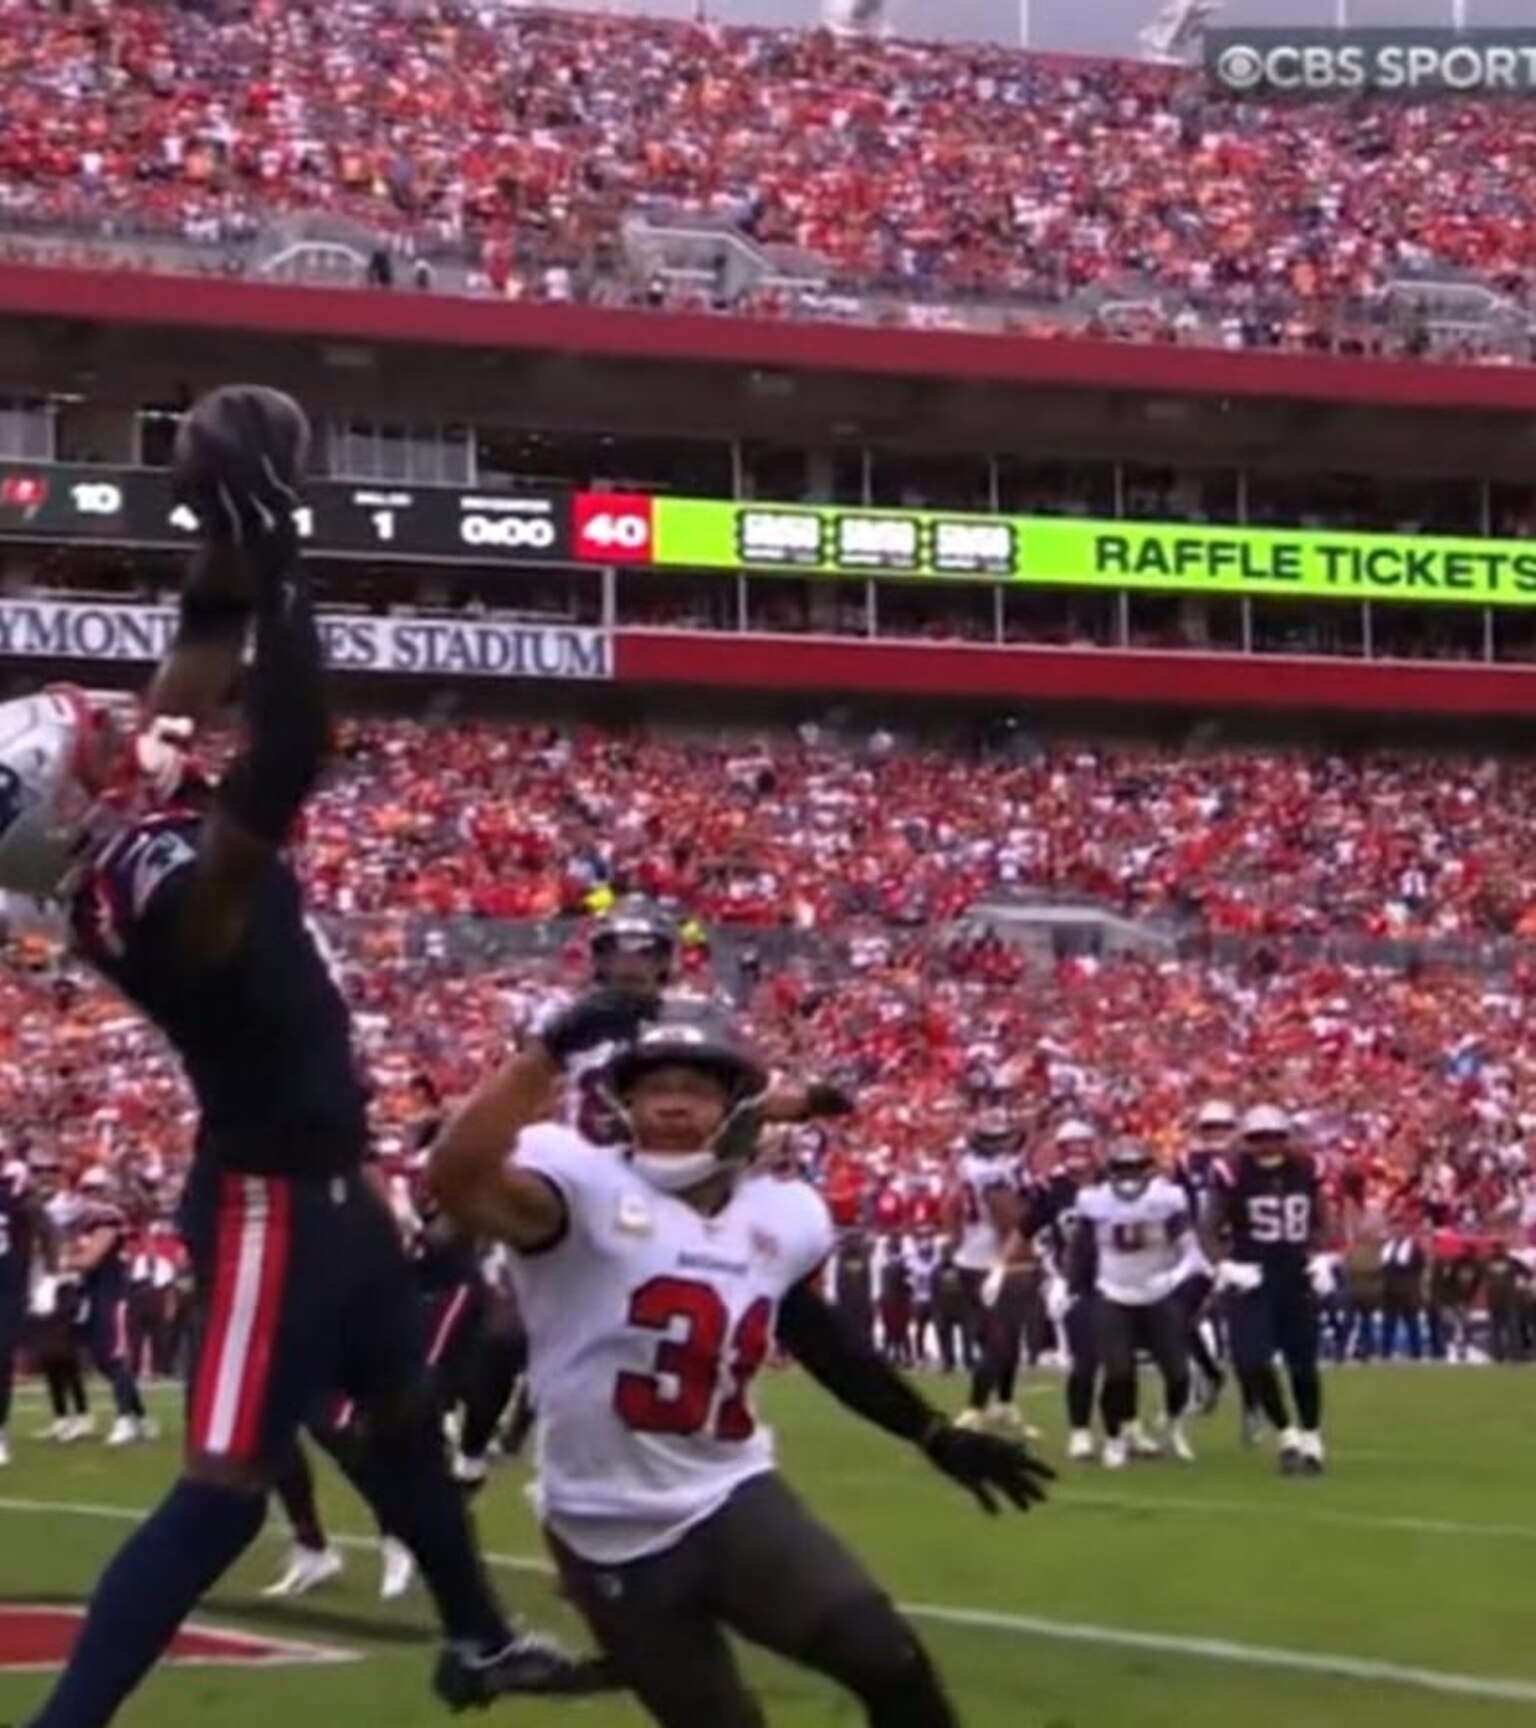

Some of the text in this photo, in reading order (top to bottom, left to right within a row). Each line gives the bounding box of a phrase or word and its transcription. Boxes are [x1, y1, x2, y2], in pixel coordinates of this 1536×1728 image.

[70, 482, 123, 514] 10
[372, 510, 395, 541] 1
[582, 513, 649, 548] 40
[1093, 534, 1536, 592] RAFFLE TICKETS
[390, 624, 607, 674] STADIUM
[1249, 1193, 1311, 1244] 58
[613, 1274, 774, 1443] 31
